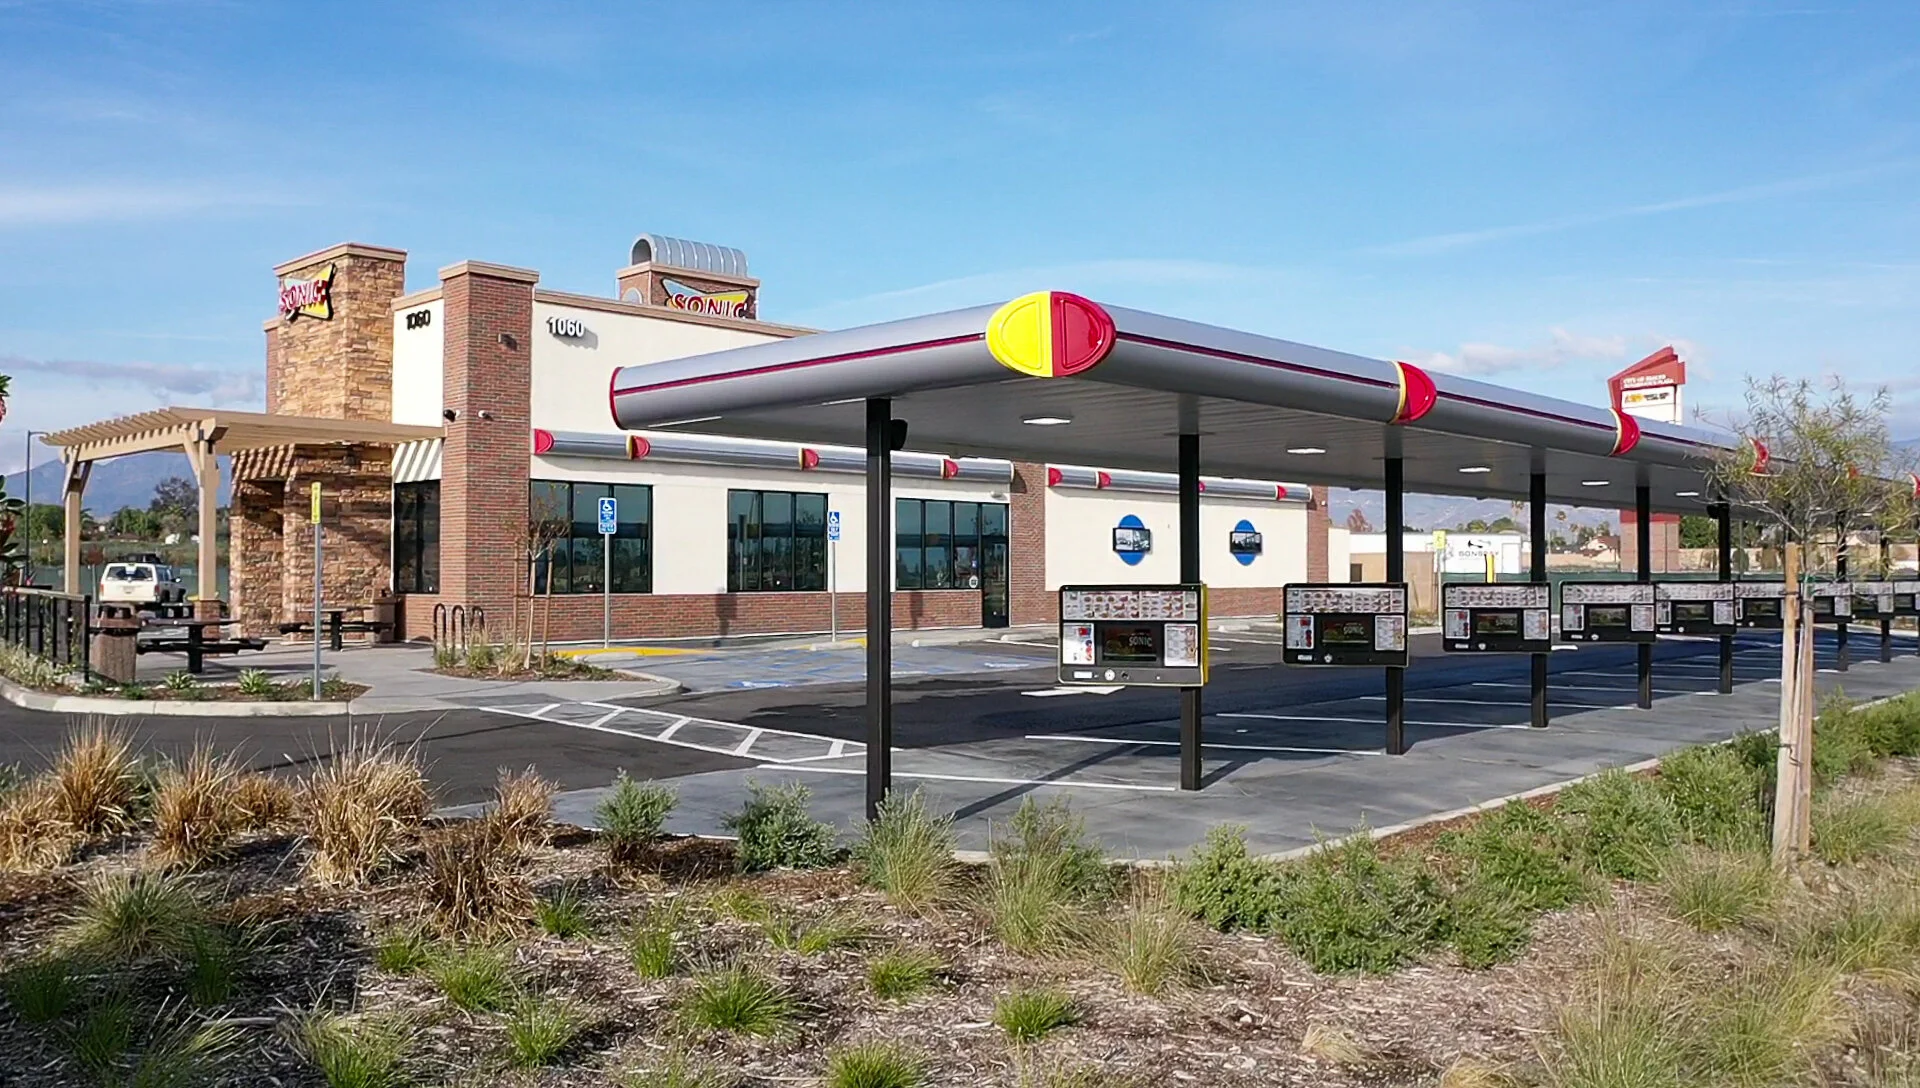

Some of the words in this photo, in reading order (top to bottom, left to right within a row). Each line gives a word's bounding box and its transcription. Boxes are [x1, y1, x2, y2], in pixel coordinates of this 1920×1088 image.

[279, 280, 327, 313] SONIC
[672, 292, 748, 319] SONIC
[406, 309, 431, 330] 1060
[547, 317, 585, 337] 1060
[1128, 636, 1153, 647] SONIC
